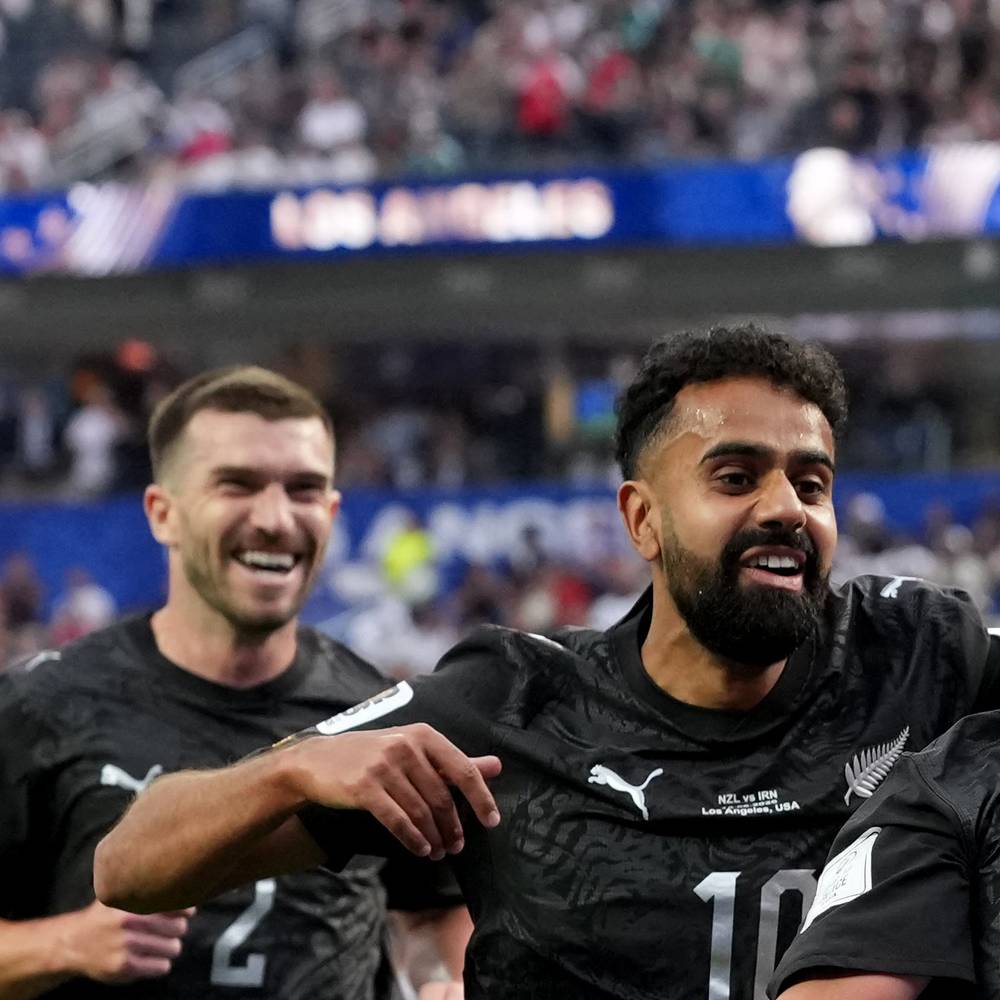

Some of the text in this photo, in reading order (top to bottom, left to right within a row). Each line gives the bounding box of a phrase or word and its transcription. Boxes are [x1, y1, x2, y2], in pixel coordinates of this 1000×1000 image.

[718, 793, 740, 804] NZL
[742, 794, 755, 802] vs
[758, 789, 777, 800] IRN
[702, 806, 721, 815] Los
[724, 804, 773, 816] Angeles,
[775, 800, 799, 812] USA
[211, 878, 277, 987] 2
